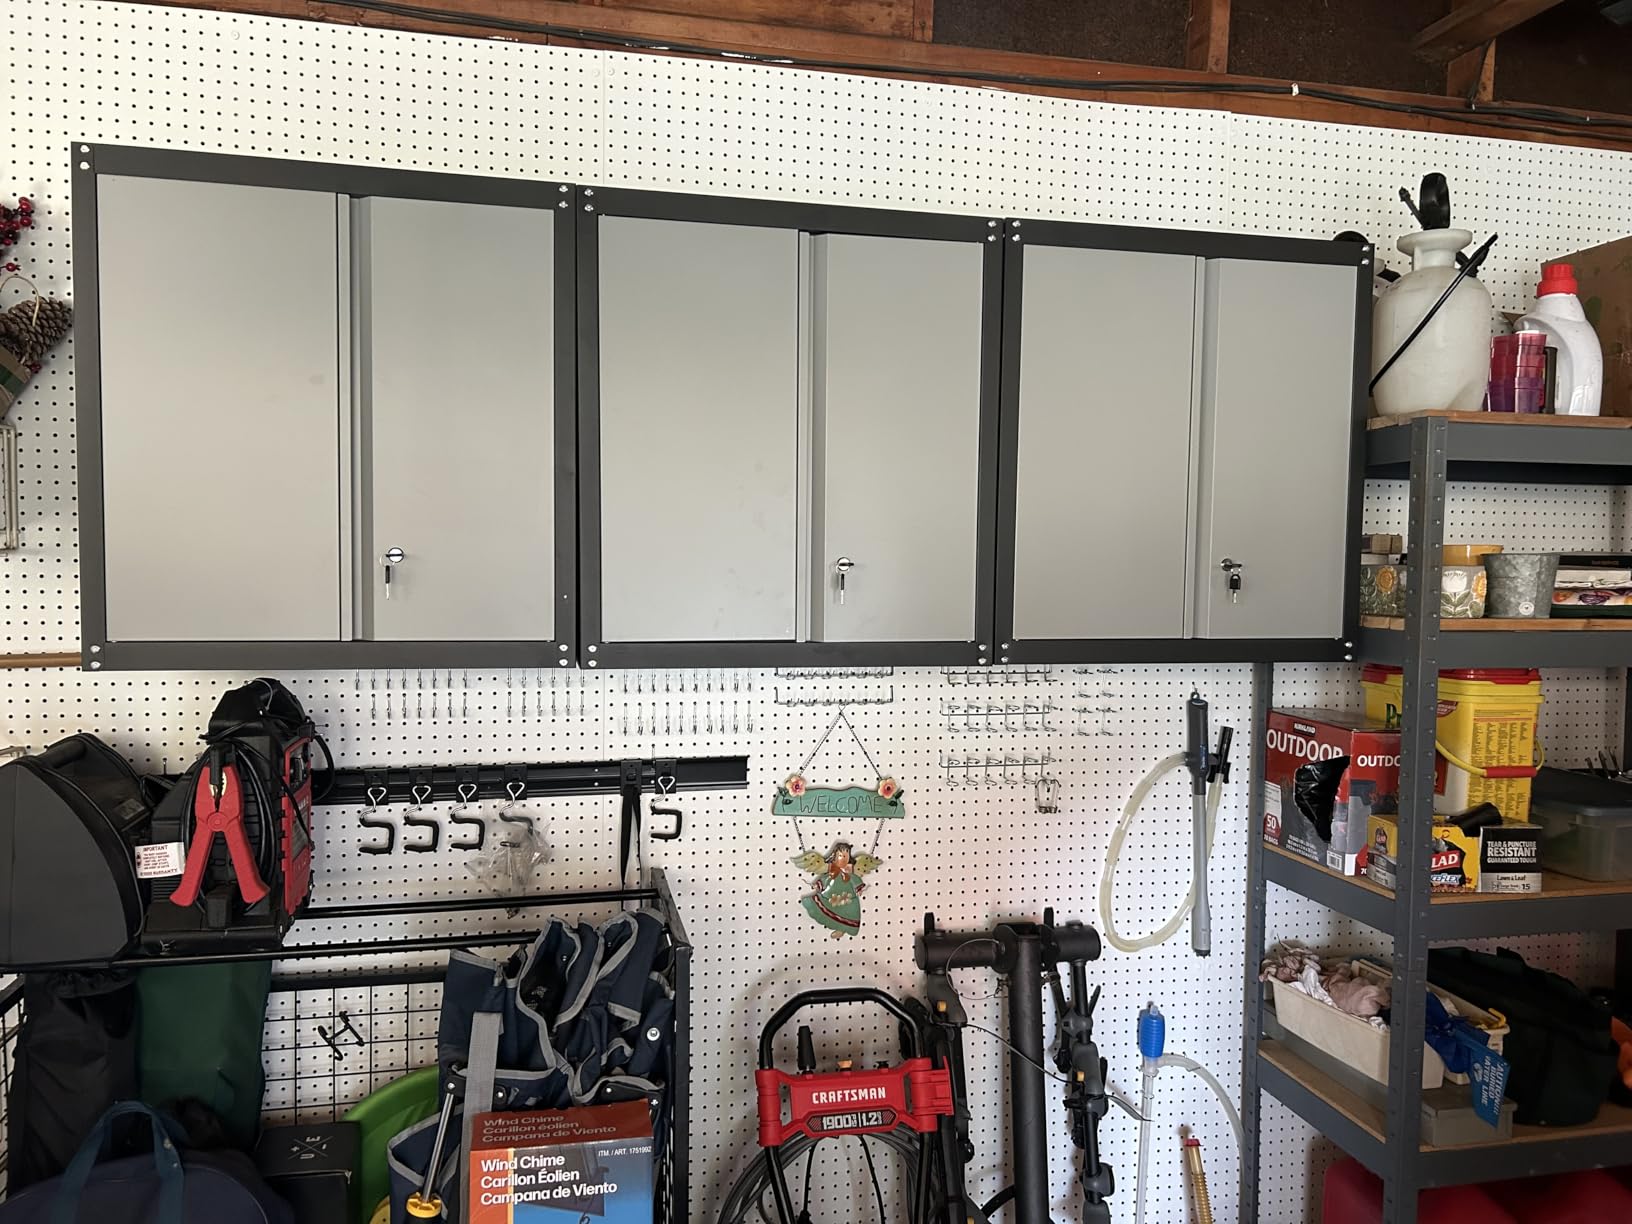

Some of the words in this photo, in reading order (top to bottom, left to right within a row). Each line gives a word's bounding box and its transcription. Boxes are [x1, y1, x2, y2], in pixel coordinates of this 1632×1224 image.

[799, 795, 883, 814] WELCOME
[1266, 815, 1277, 829] 50
[1487, 847, 1537, 857] RESISTANT
[1489, 1065, 1497, 1099] BURIED
[1493, 1062, 1508, 1115] AUTION!!!
[812, 1086, 886, 1104] CRAFTSMAN
[1481, 1084, 1489, 1106] LINE
[483, 1125, 536, 1134] Carillon
[538, 1121, 579, 1131] éolien
[484, 1118, 519, 1127] Wind
[522, 1115, 564, 1124] Chime
[822, 1114, 852, 1130] 1900
[861, 1111, 877, 1127] 1.2
[482, 1132, 550, 1142] Campana
[553, 1129, 571, 1137] de
[573, 1126, 617, 1135] Viento
[481, 1159, 518, 1173] Wind
[520, 1155, 566, 1170] Chime
[480, 1174, 536, 1189] Carillon
[538, 1168, 580, 1184] Éolien
[480, 1189, 551, 1205] Campana
[553, 1185, 571, 1198] de
[573, 1182, 618, 1197] Viento
